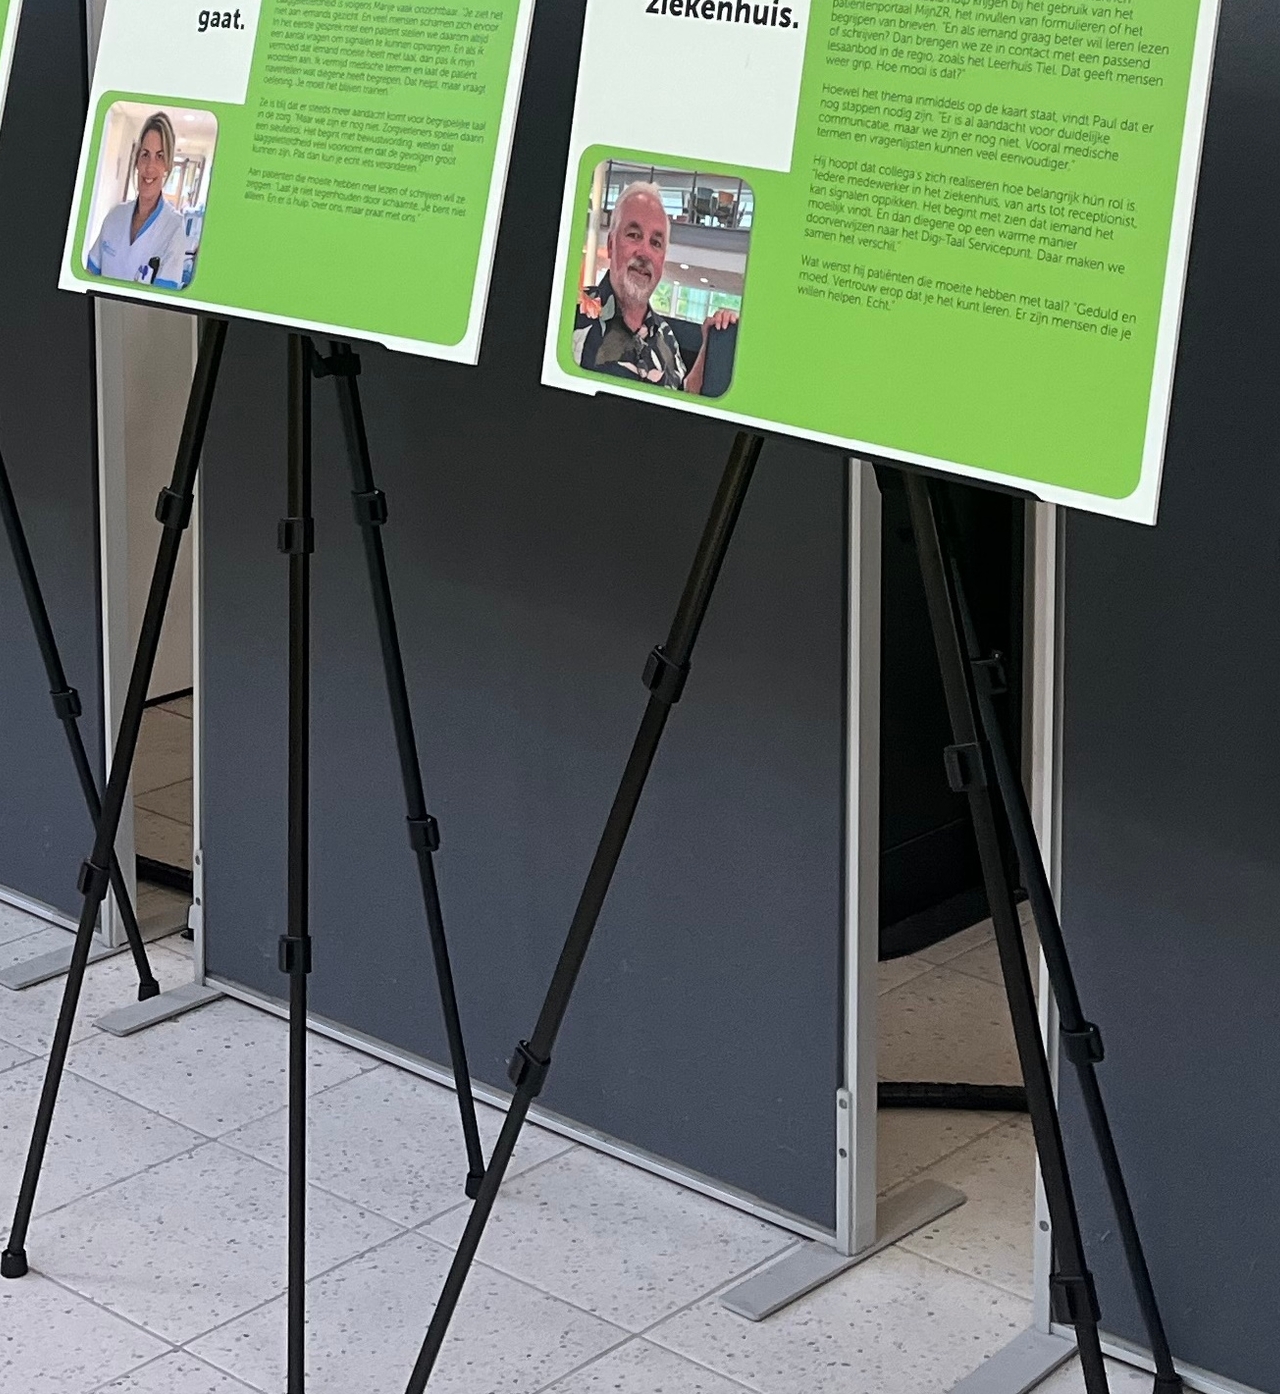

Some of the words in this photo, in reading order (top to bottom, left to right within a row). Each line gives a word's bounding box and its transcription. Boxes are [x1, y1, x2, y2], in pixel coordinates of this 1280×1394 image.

[197, 9, 245, 33] gaat.
[822, 82, 860, 98] Hoewel
[862, 88, 879, 100] het
[881, 90, 913, 105] thema
[915, 96, 965, 111] inmiddels
[967, 102, 983, 115] op
[984, 102, 999, 115] de
[1001, 104, 1028, 119] kaart
[1062, 114, 1090, 127] vindt
[1092, 114, 1118, 130] Paul
[1120, 119, 1139, 133] dat
[1141, 123, 1155, 134] er
[806, 212, 875, 233] doorverwijzen
[877, 225, 900, 237] naar
[901, 226, 919, 241] het
[1037, 248, 1063, 264] Daar
[1066, 256, 1105, 271] maken
[1107, 263, 1126, 275] we
